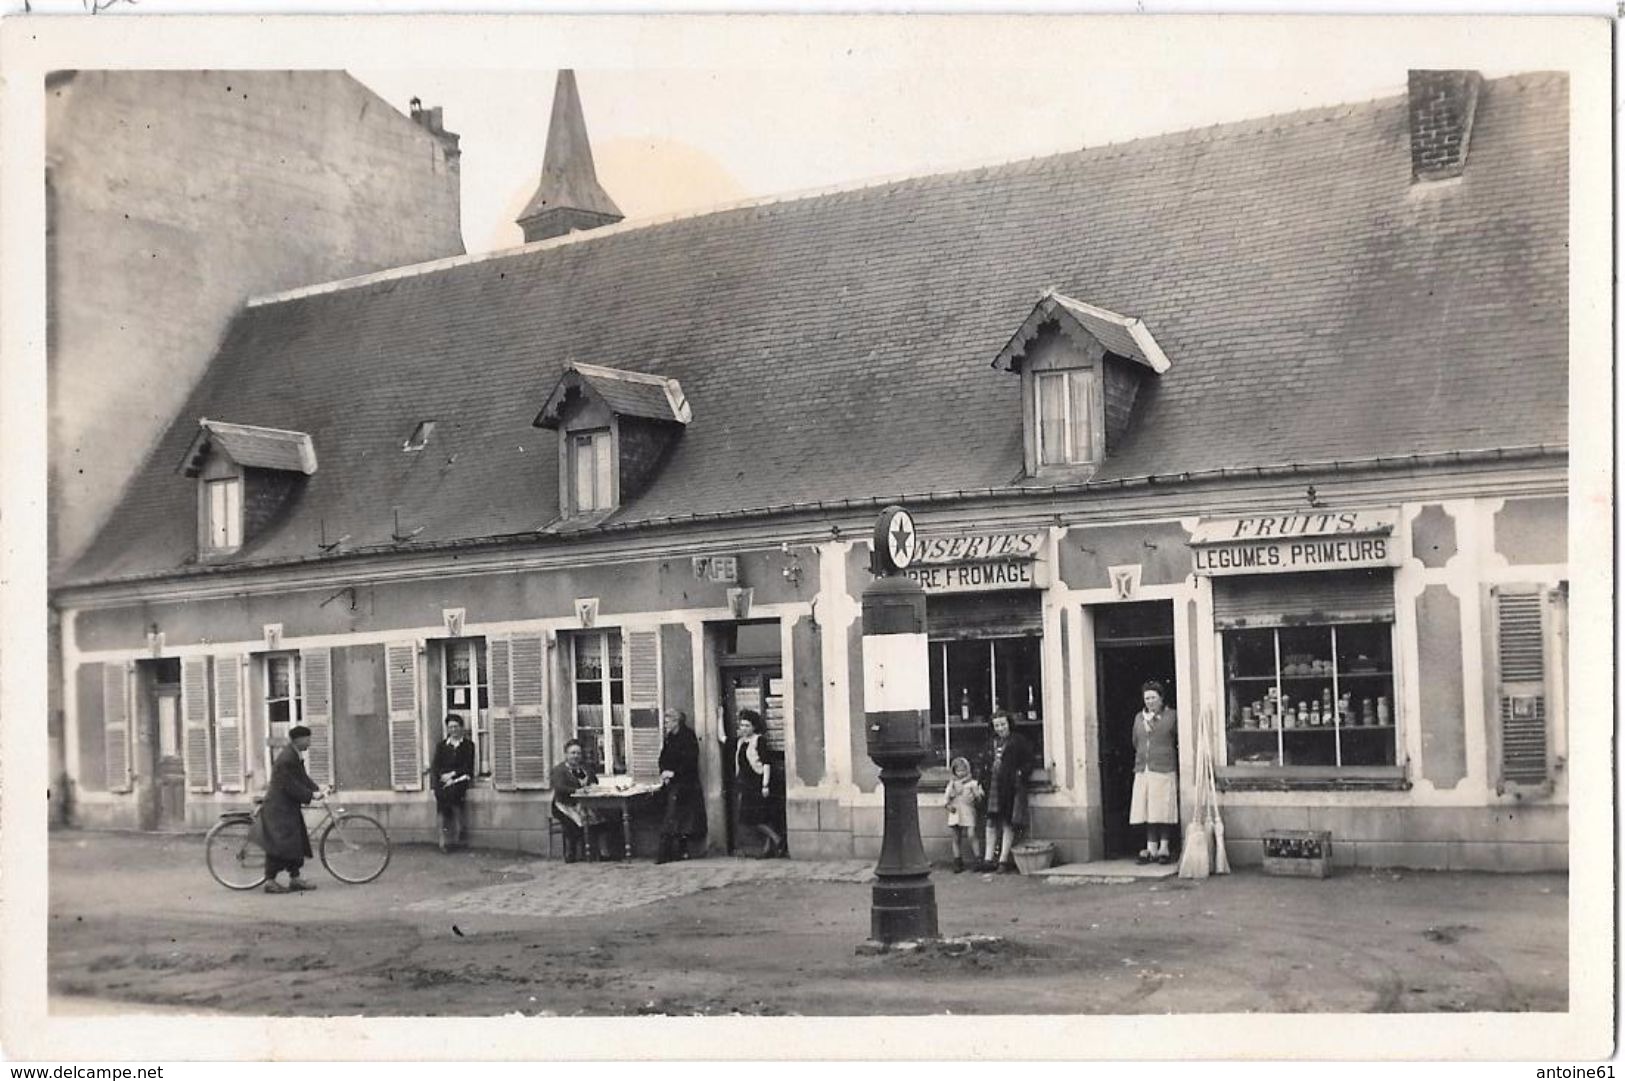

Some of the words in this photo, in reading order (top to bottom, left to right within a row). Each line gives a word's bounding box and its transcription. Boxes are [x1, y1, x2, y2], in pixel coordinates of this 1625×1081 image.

[914, 534, 1037, 559] NSERVES
[1291, 540, 1387, 564] PRIMEURS
[947, 565, 1030, 586] FROMAGE
